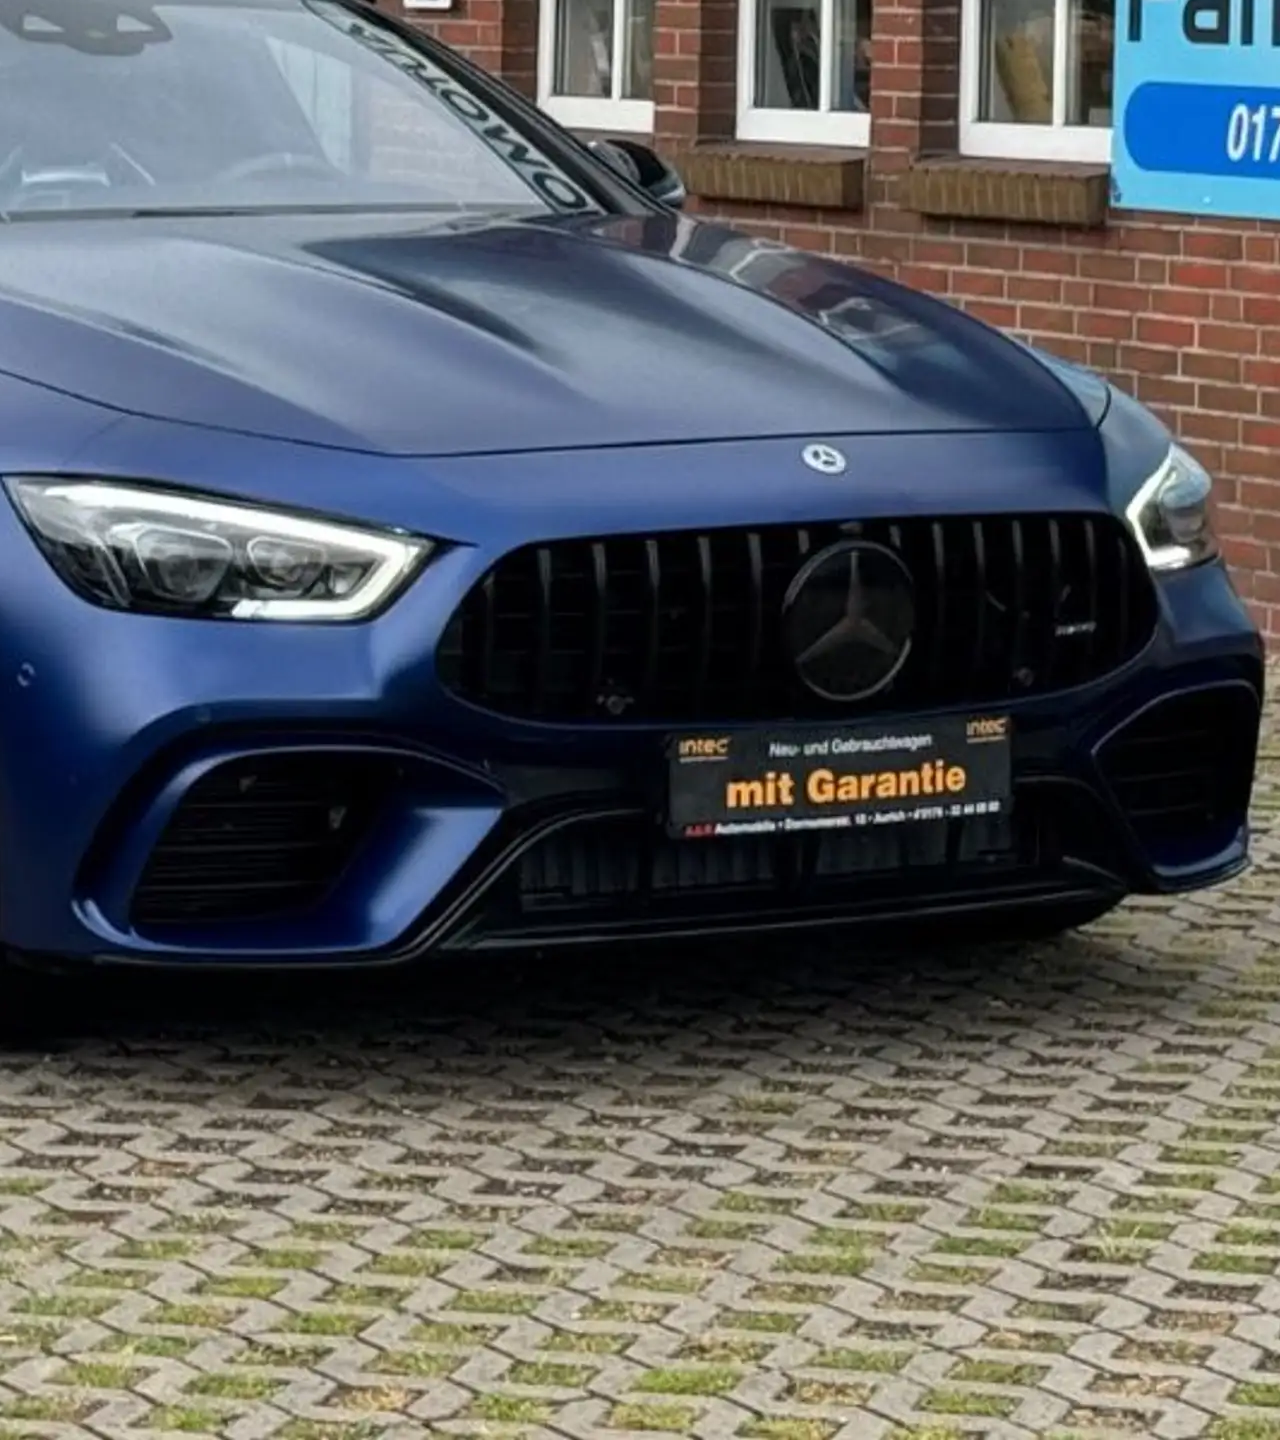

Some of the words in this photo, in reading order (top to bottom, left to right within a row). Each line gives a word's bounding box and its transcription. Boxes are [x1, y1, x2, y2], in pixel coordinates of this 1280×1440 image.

[803, 740, 829, 755] und
[726, 772, 795, 808] mit
[806, 759, 967, 803] Garantie
